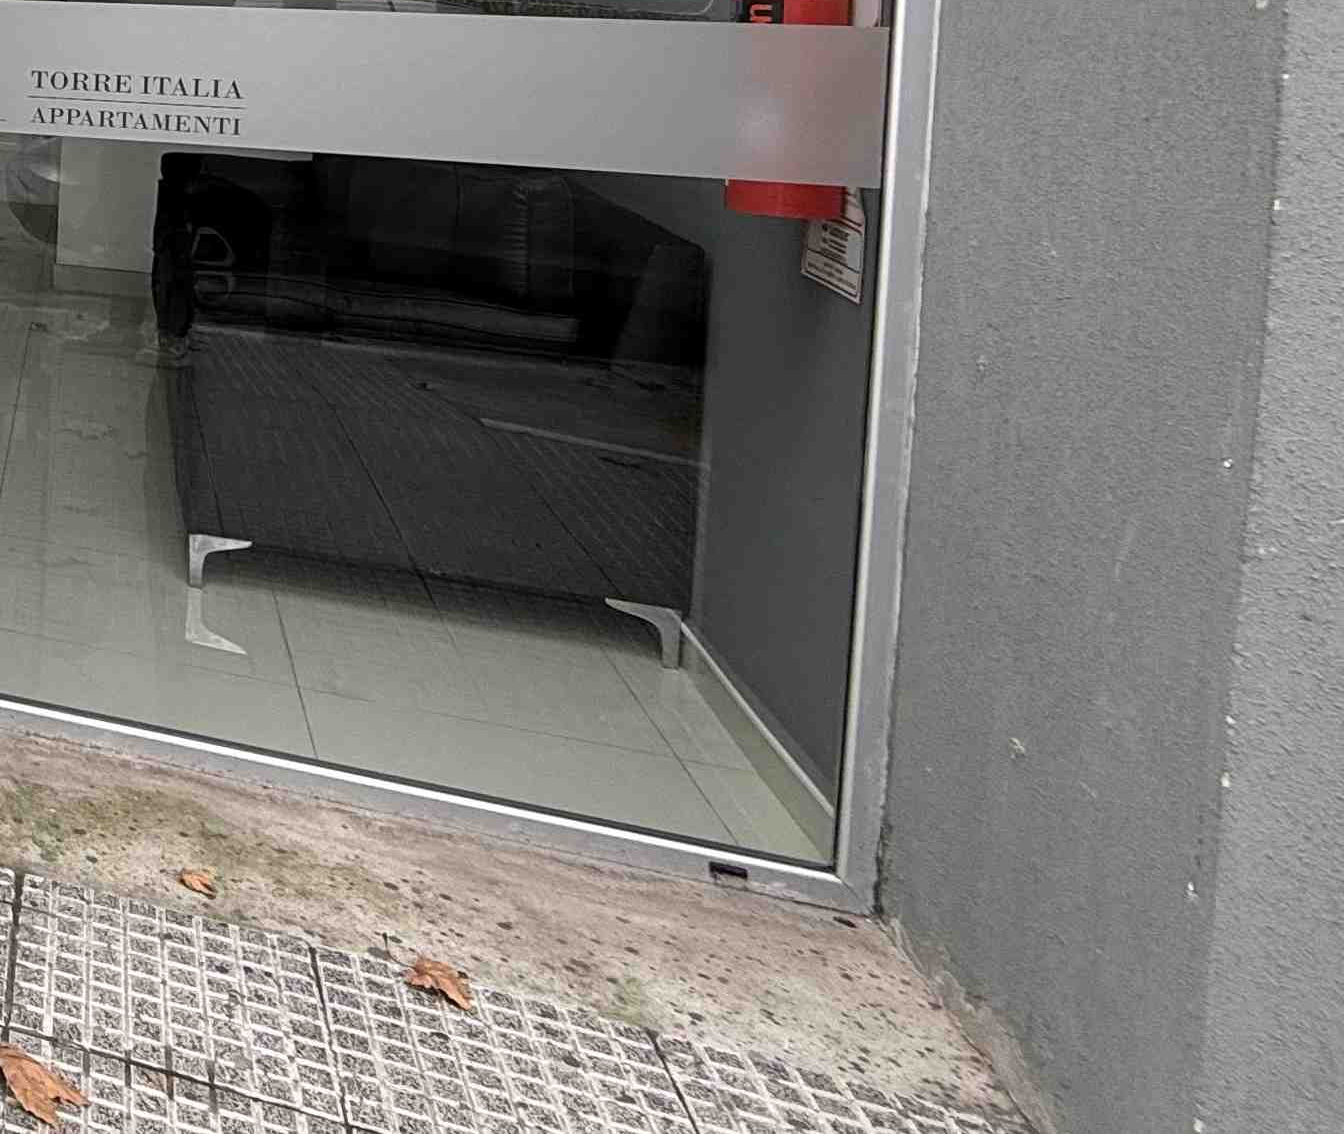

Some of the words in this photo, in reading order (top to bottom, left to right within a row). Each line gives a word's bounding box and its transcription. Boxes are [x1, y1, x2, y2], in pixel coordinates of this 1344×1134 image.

[31, 69, 133, 95] TORRE
[140, 74, 245, 100] ITALIA
[31, 106, 242, 137] APPARTAMENTI
